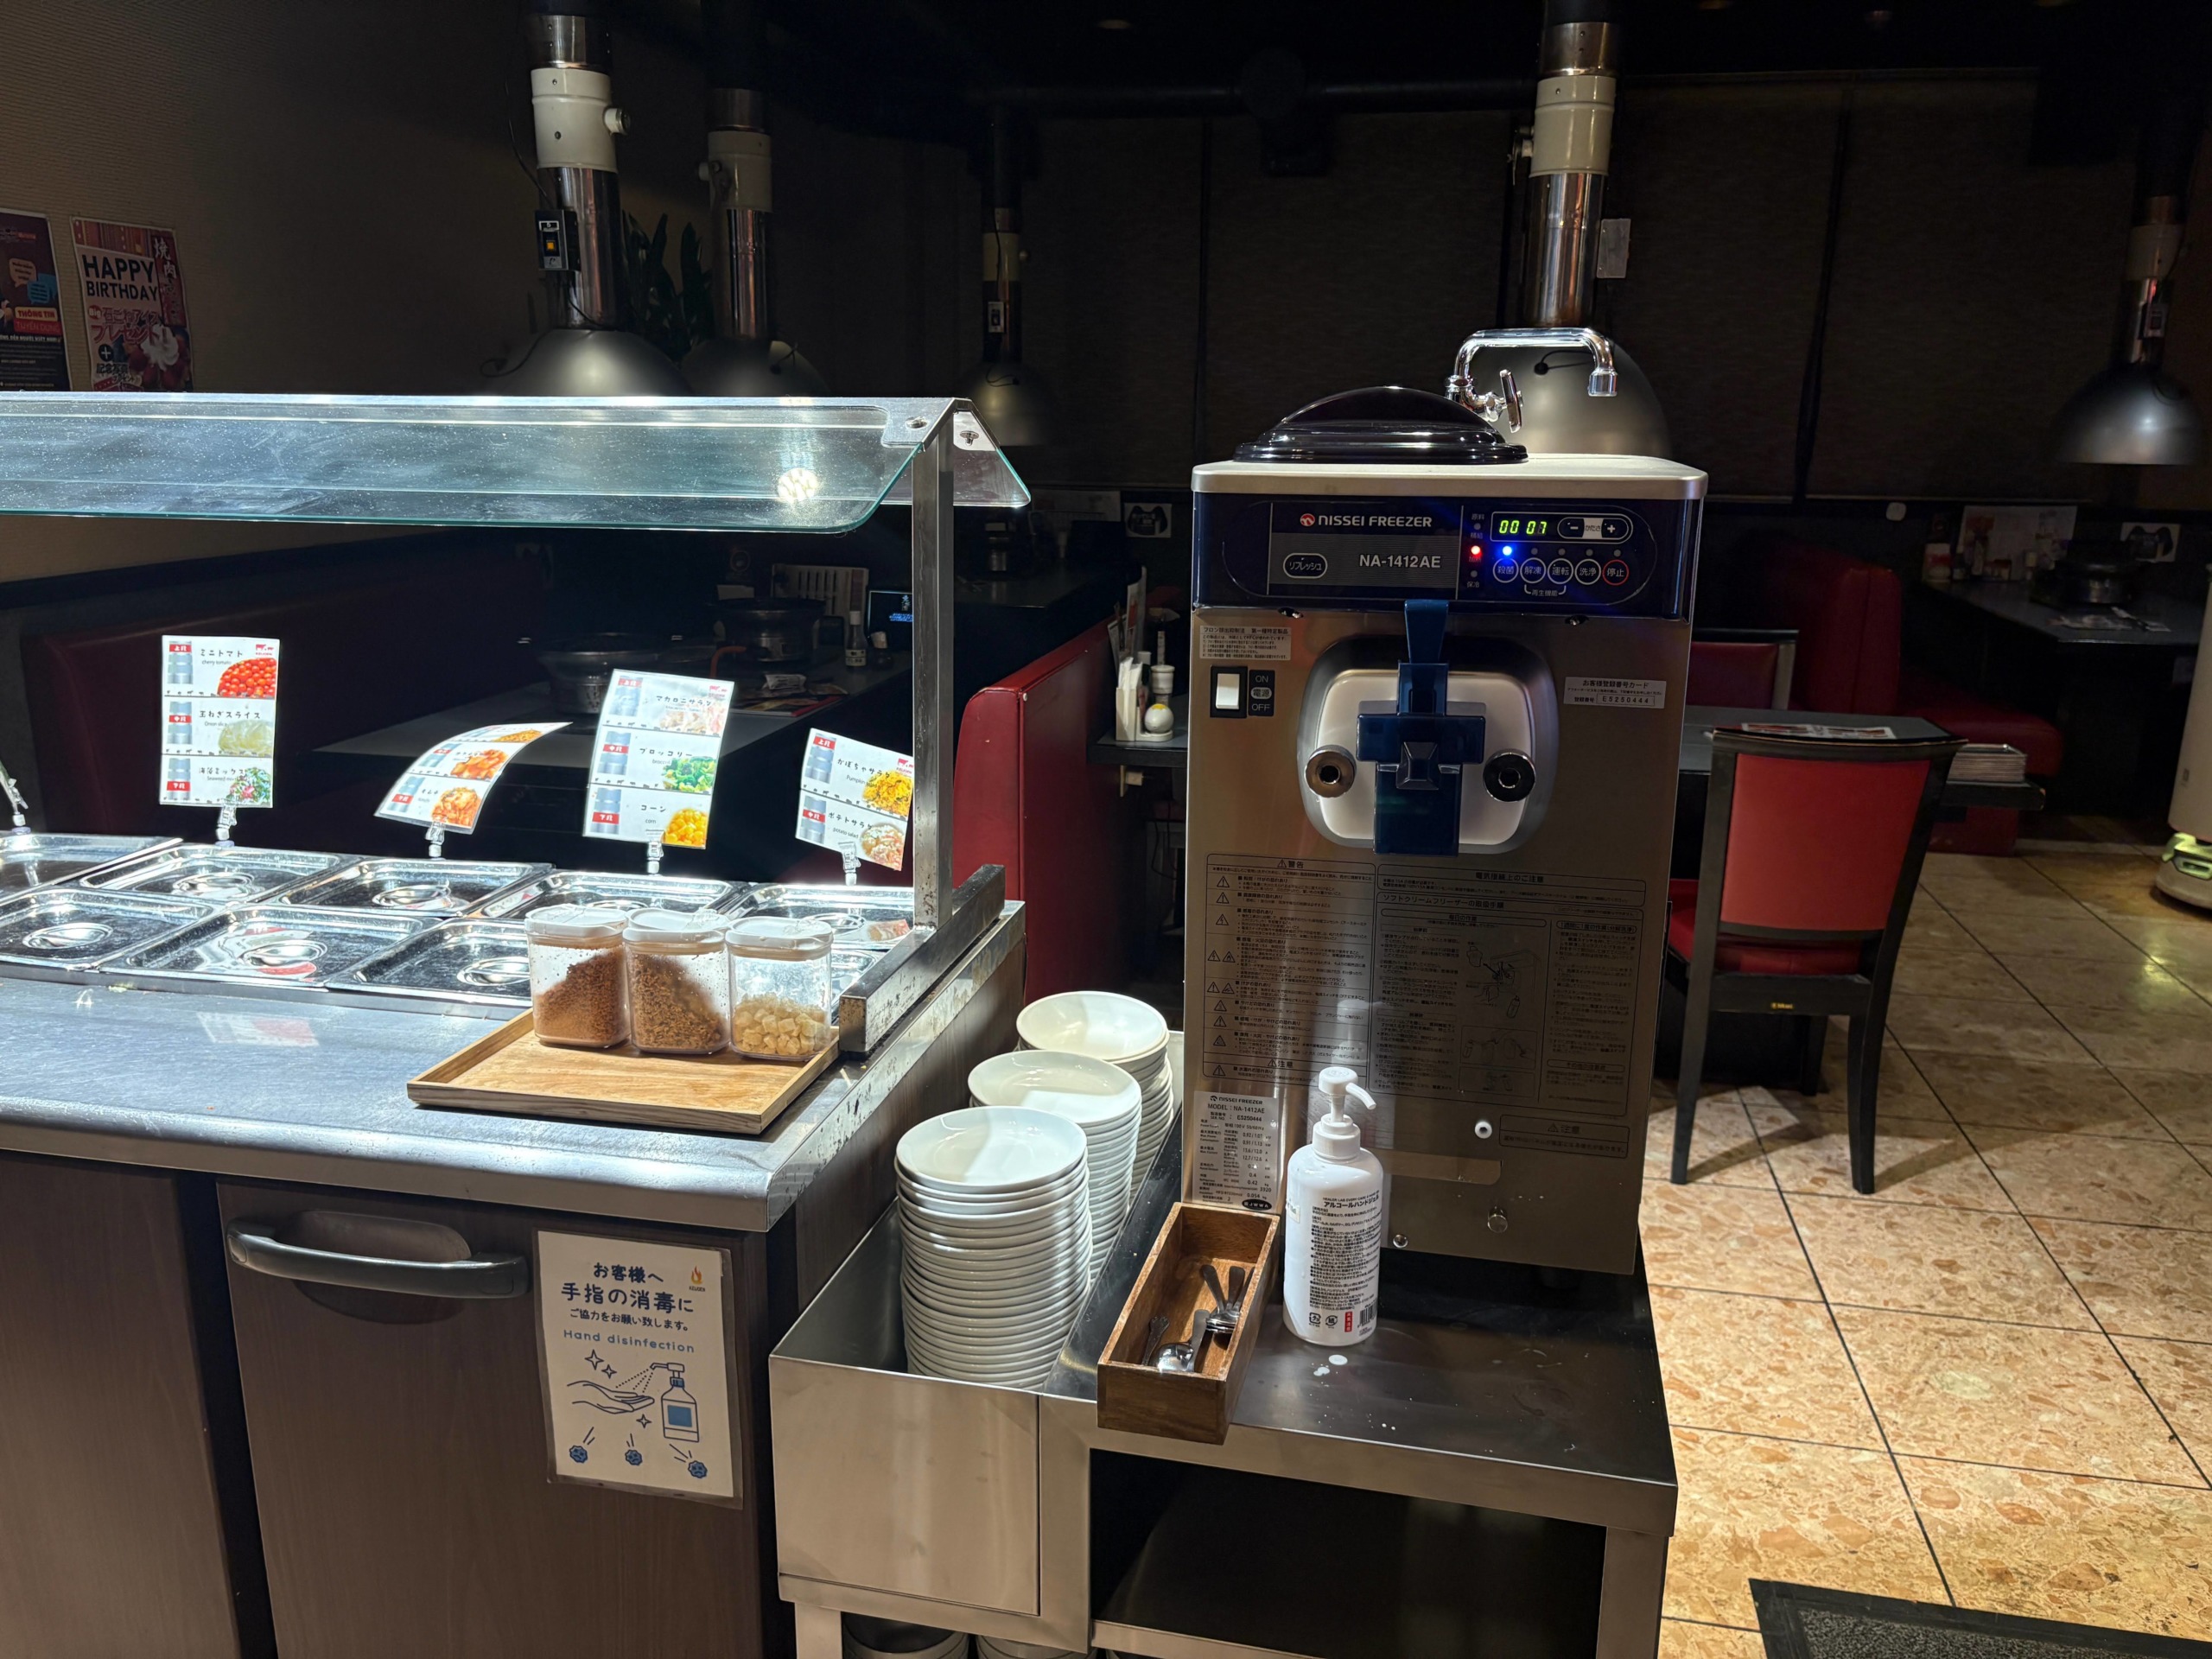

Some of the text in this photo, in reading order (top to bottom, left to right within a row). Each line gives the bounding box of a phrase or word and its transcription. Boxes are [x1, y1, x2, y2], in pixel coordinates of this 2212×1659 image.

[82, 255, 154, 283] HAPPY
[86, 281, 158, 301] BIRTHDAY
[1319, 515, 1433, 527] NISSEI FREEZER
[1359, 554, 1441, 568] NA-1412AE
[1289, 561, 1322, 571] リフレッシュ
[1497, 566, 1515, 575] 殺菌
[1524, 566, 1541, 575] 解凍
[1552, 566, 1569, 575] 運転
[1580, 567, 1597, 576] 洗浄
[1607, 568, 1624, 577] 停止
[200, 649, 243, 658] ミニトマト
[1583, 680, 1649, 689] お客様登録番号カード
[1253, 689, 1269, 697] 電源
[200, 710, 261, 719] 玉ねぎスライス
[639, 747, 693, 757] ブロッコリー
[847, 775, 865, 785] Pumpkin
[833, 827, 848, 836] potato
[1288, 860, 1304, 869] 警告
[1233, 1105, 1265, 1114] NA-1412AE
[1324, 1194, 1379, 1208] アルコールハンドジェル
[594, 1262, 664, 1283] お客様へ
[561, 1282, 694, 1313] 手指の消毒に
[570, 1307, 689, 1332] ご協力をお願い致します。
[563, 1329, 695, 1353] Hand disinfection
